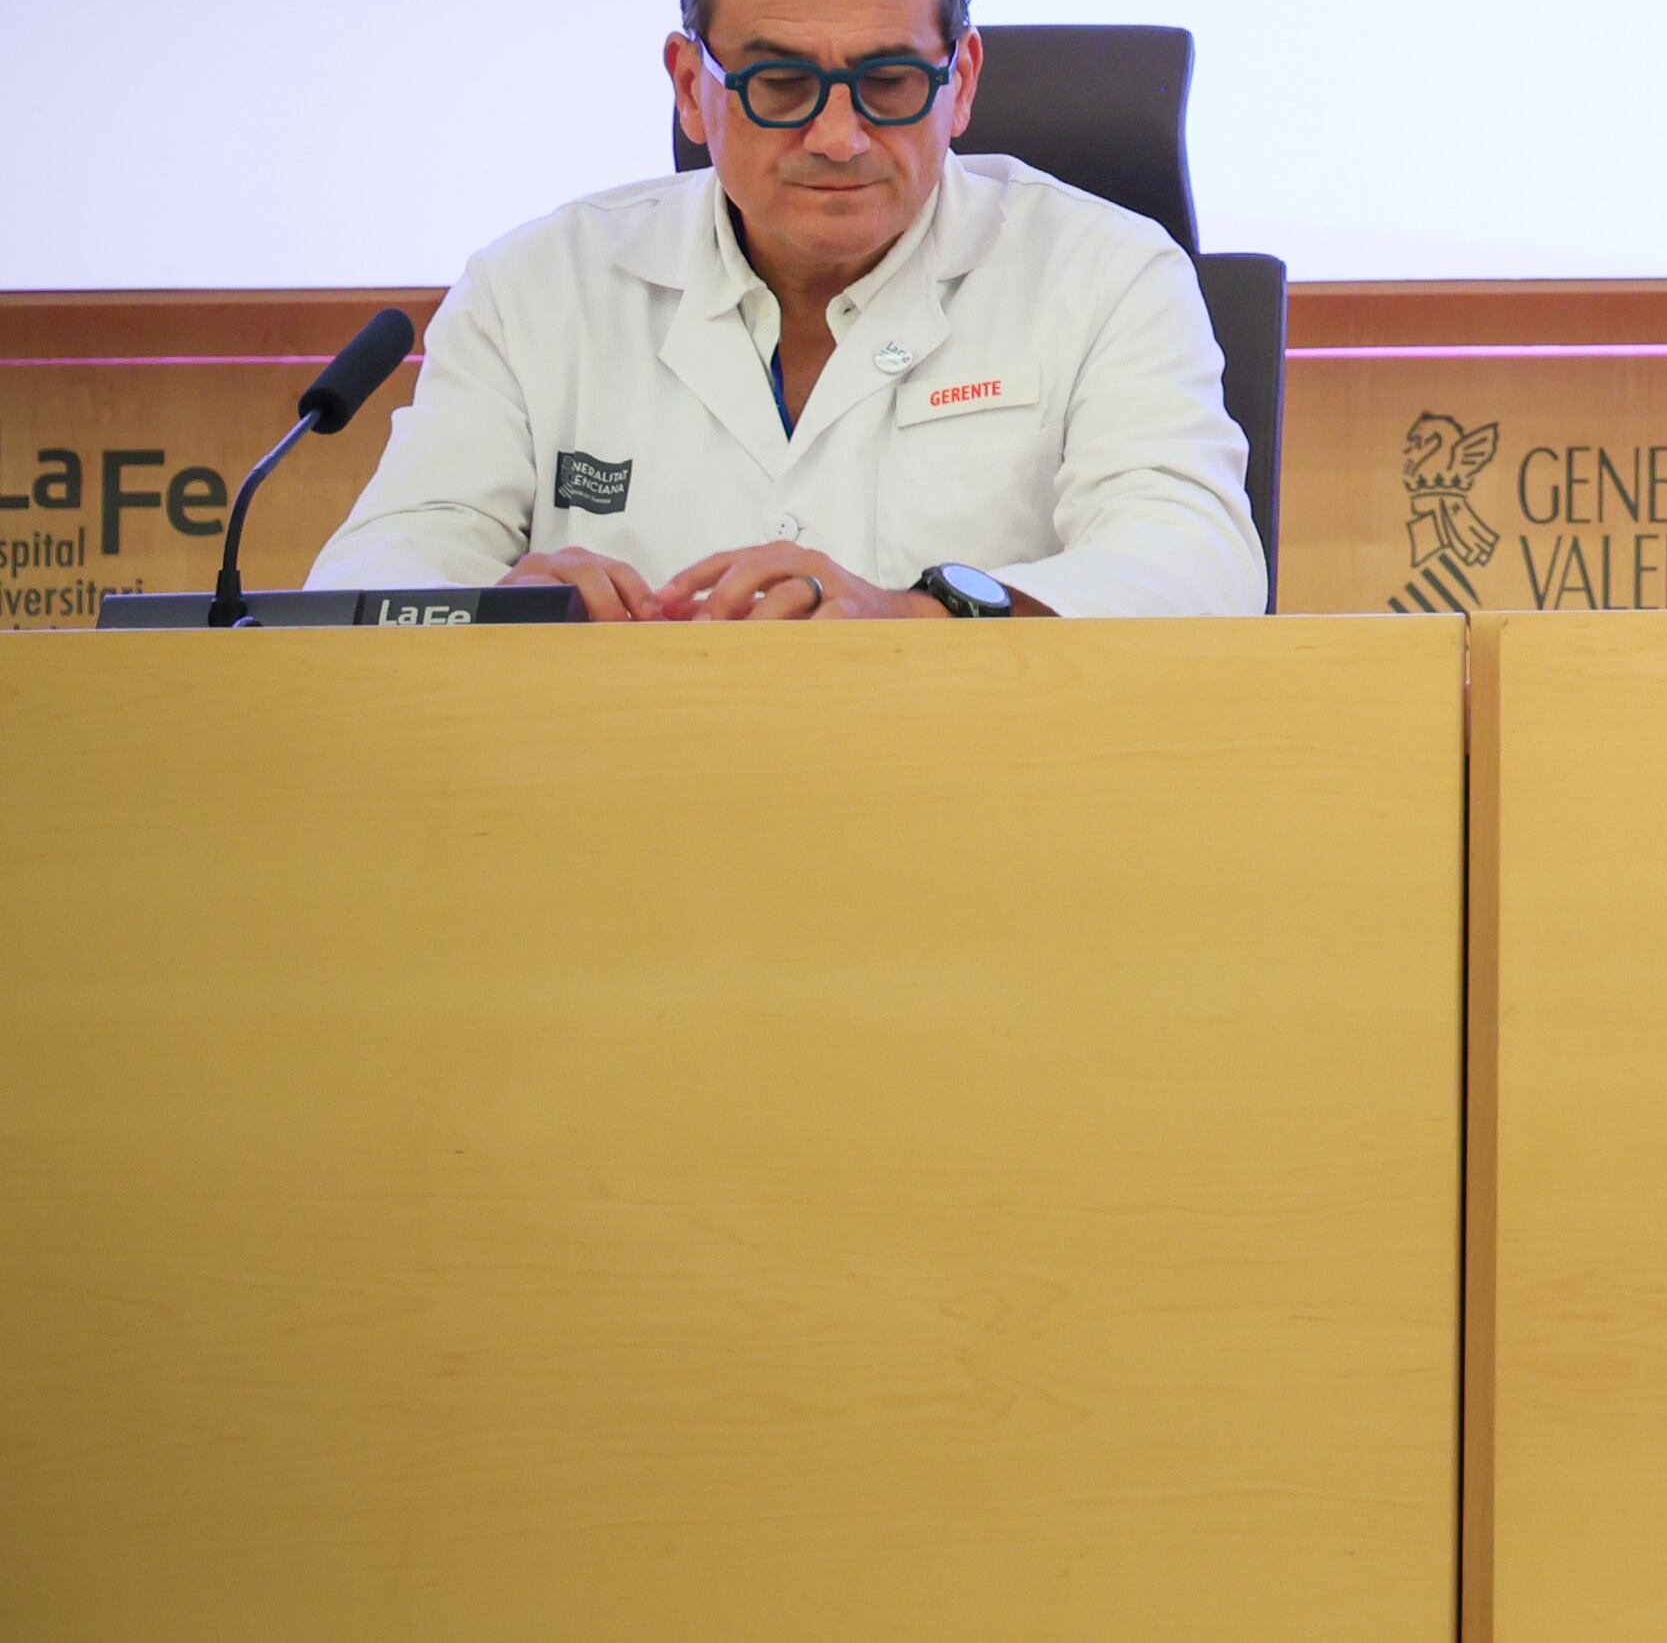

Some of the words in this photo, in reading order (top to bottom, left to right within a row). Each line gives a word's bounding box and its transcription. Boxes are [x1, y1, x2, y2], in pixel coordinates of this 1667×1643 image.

[930, 380, 1002, 407] GERENTE
[571, 461, 628, 483] NERALITAT
[572, 474, 625, 494] ENCIANA
[0, 526, 85, 579] spital
